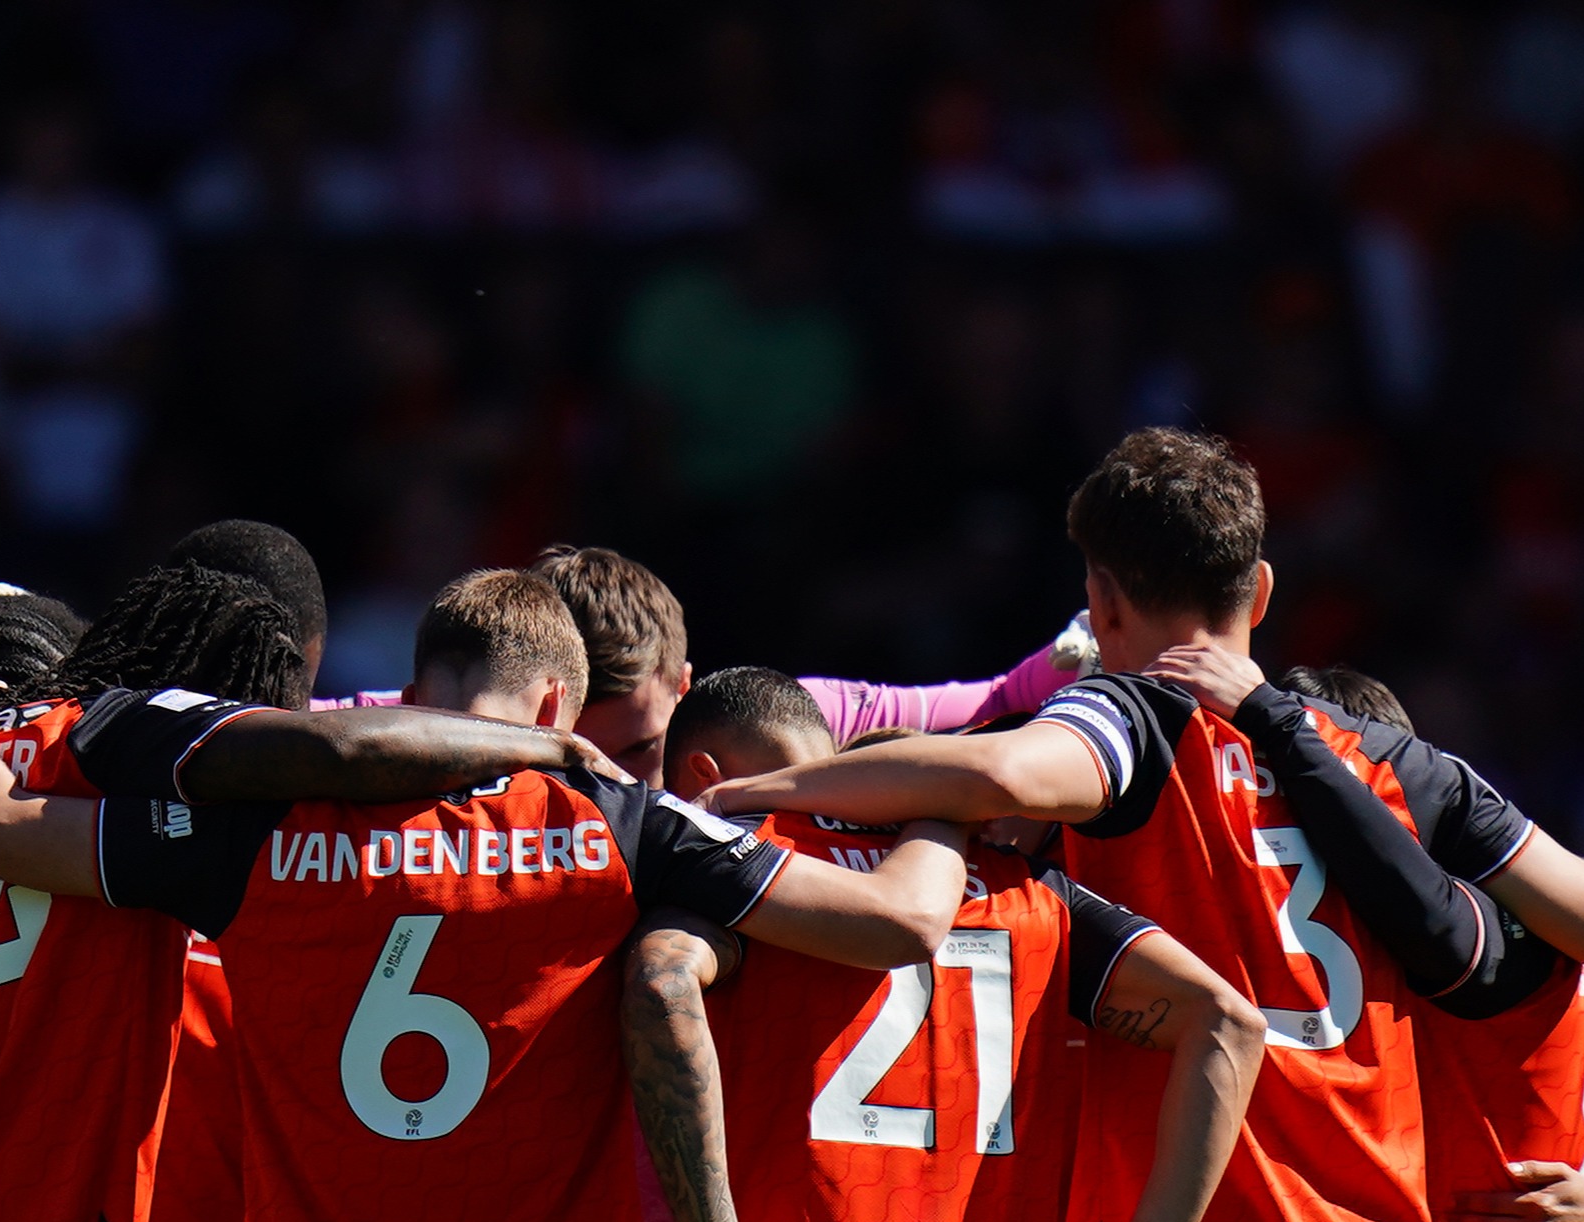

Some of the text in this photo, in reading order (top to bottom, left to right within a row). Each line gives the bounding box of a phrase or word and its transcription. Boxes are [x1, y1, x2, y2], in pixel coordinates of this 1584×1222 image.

[477, 820, 610, 875] BERG
[1251, 827, 1363, 1049] 3
[339, 914, 491, 1141] 6
[406, 1128, 421, 1137] EFL
[809, 929, 1015, 1155] 21
